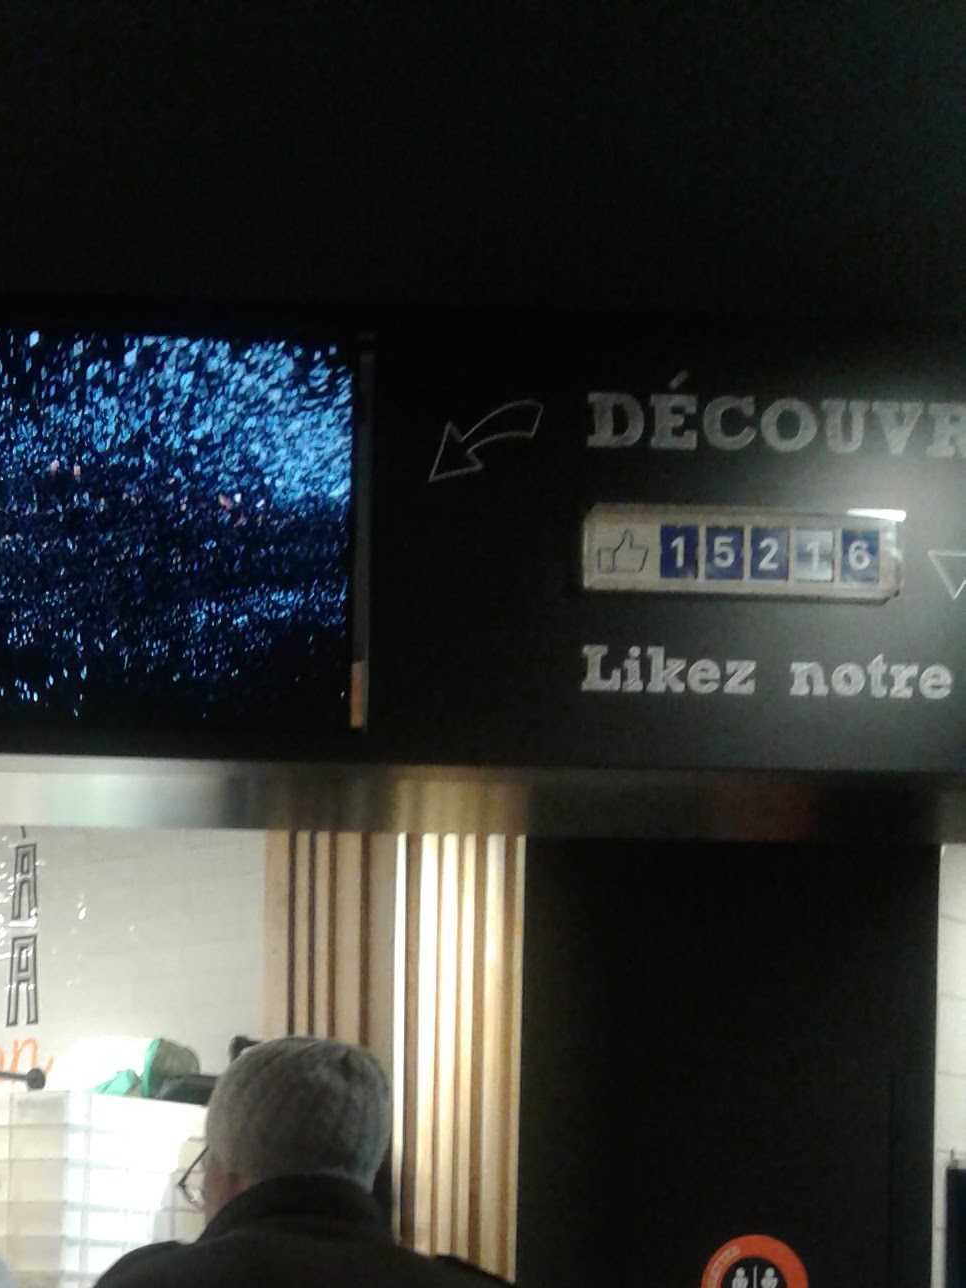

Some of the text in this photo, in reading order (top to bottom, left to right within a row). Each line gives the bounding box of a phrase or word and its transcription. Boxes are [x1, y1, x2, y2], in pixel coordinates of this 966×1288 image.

[586, 370, 966, 458] DÉCOUVR
[666, 530, 874, 574] 15216
[581, 645, 953, 699] Likez notre
[11, 826, 38, 921] À
